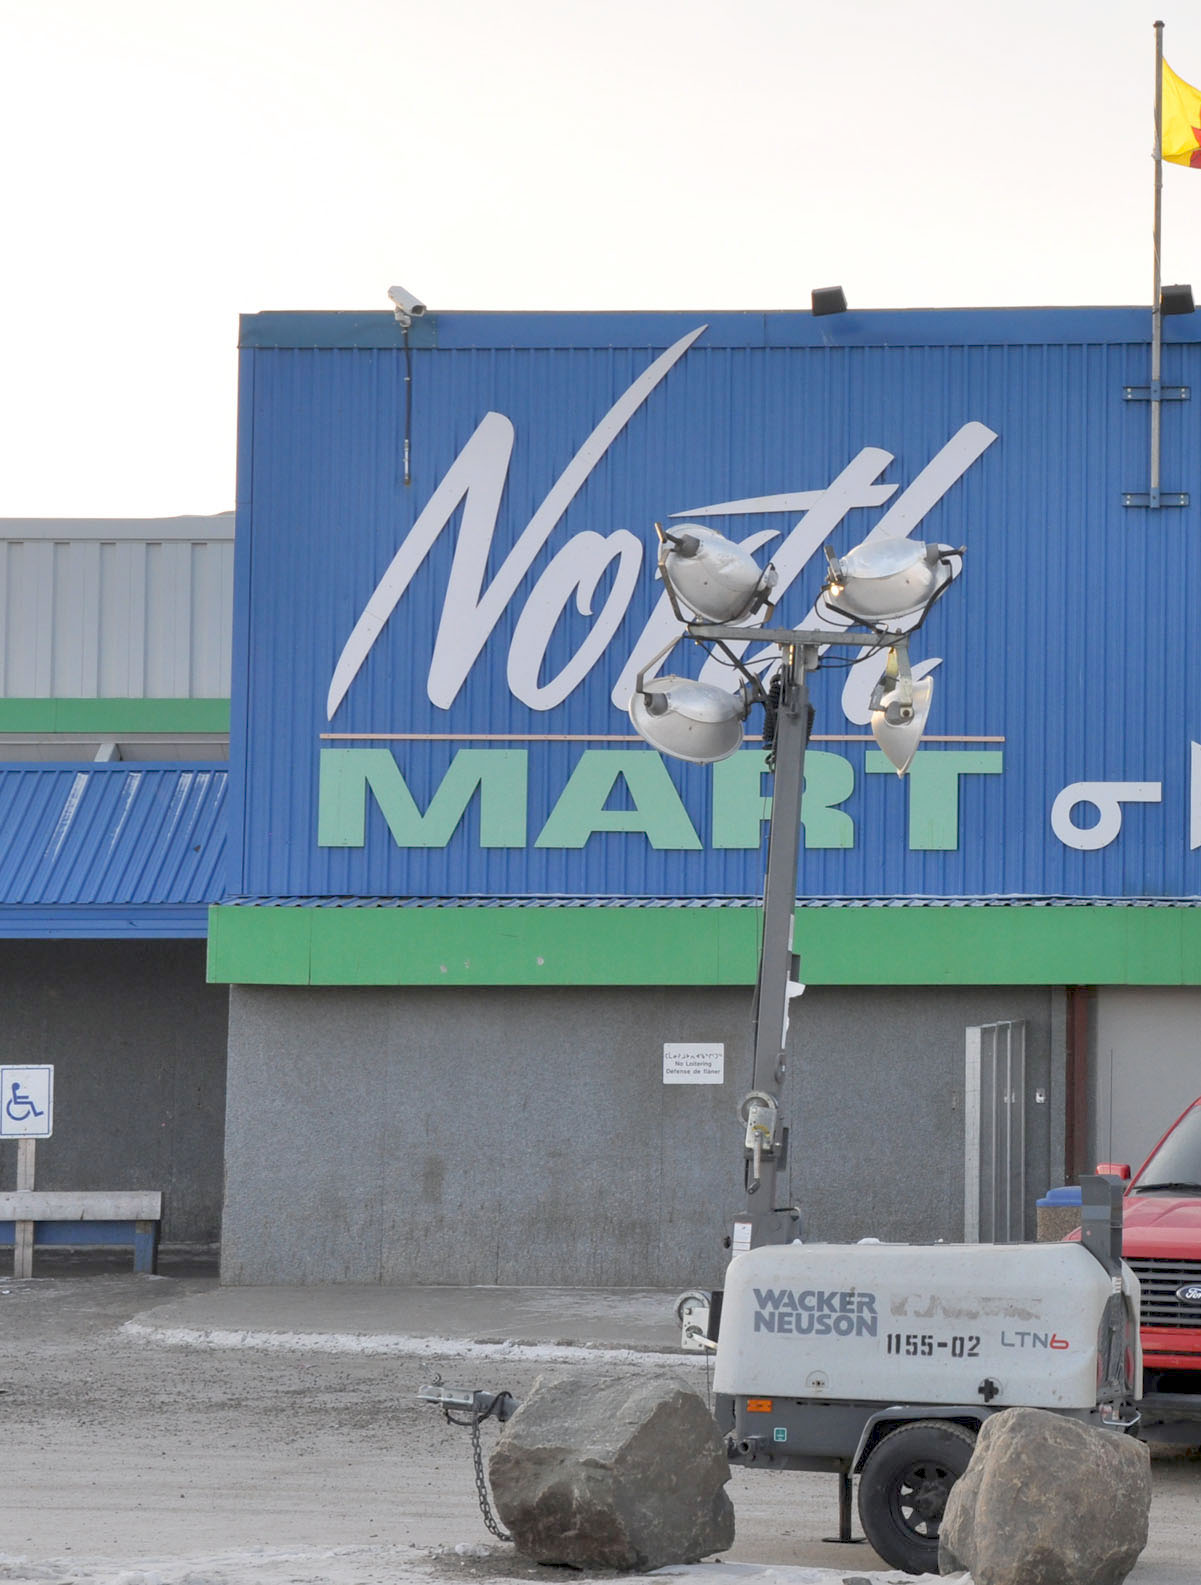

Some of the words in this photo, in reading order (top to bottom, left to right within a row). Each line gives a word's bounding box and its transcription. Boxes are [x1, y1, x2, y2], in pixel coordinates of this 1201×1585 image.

[317, 748, 1004, 851] MART
[685, 1060, 712, 1068] Loitering
[753, 1288, 878, 1315] WACKER
[754, 1311, 879, 1338] NEUSON
[886, 1333, 982, 1358] 1155-02
[1001, 1330, 1070, 1350] LTN6
